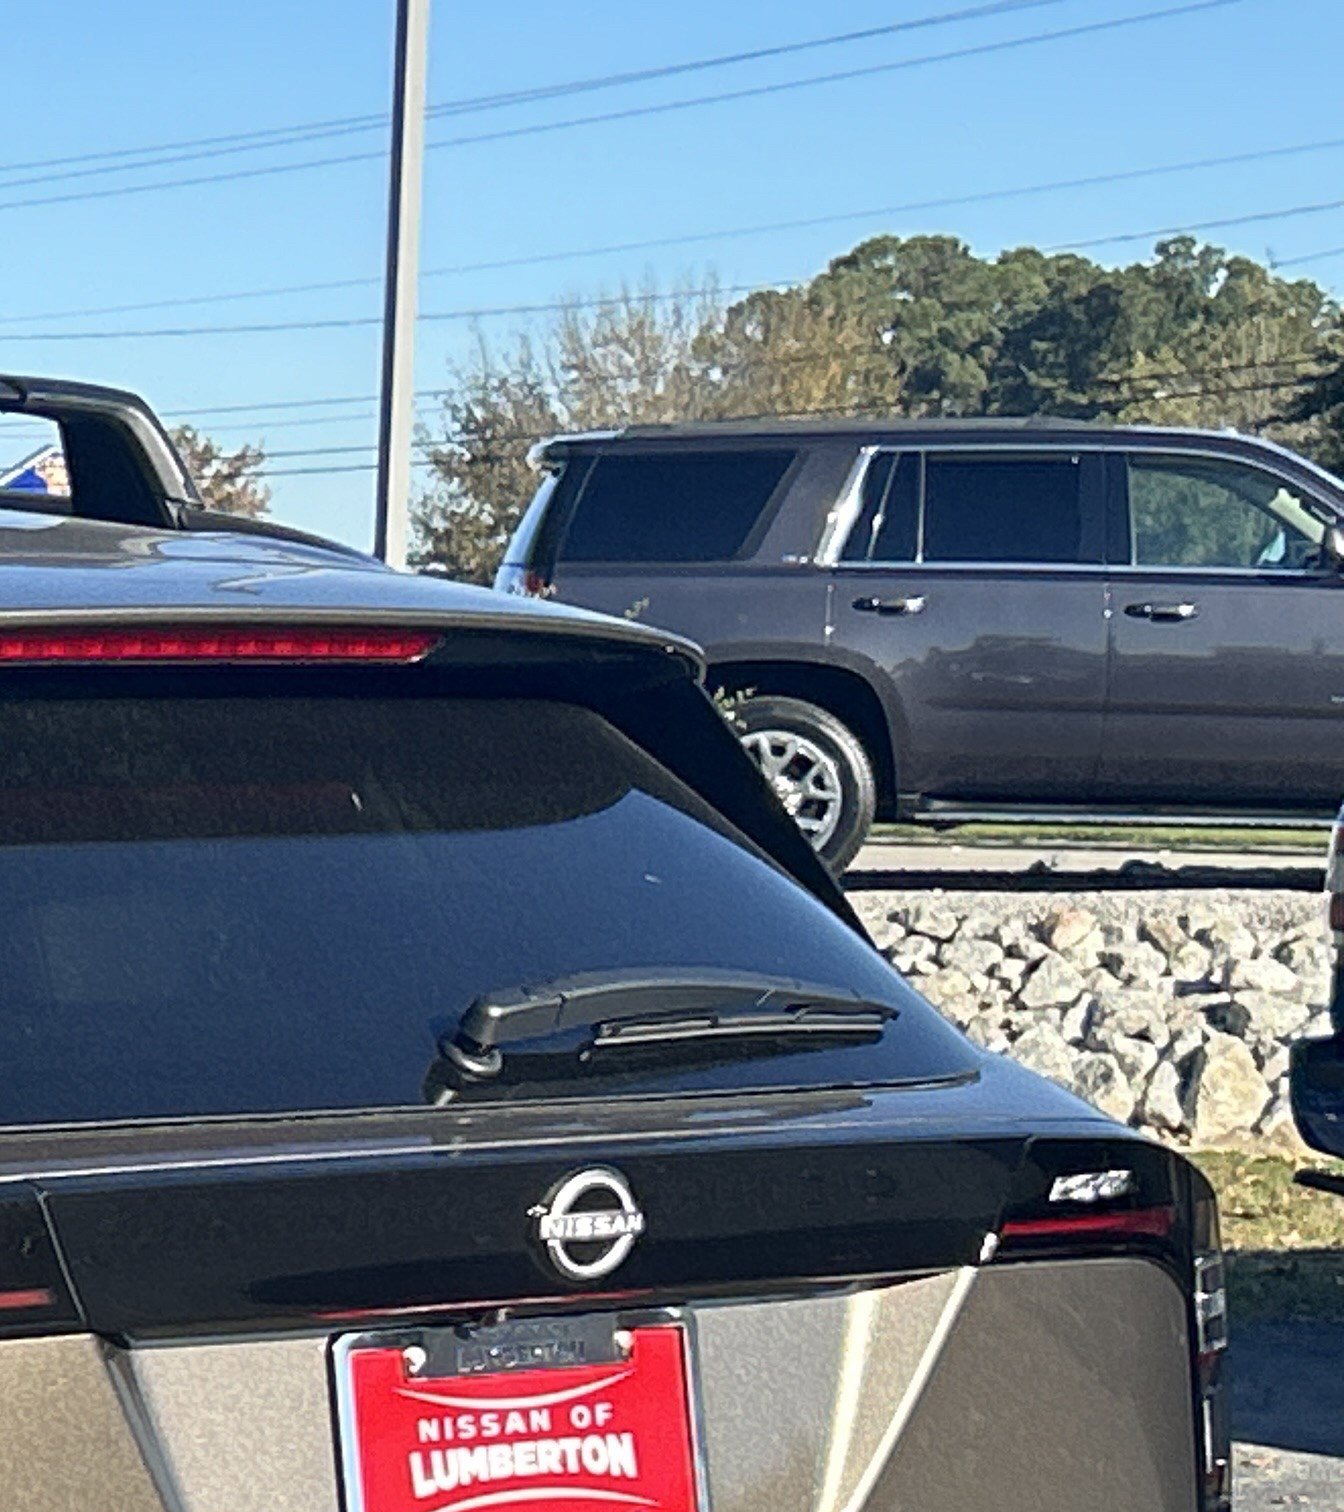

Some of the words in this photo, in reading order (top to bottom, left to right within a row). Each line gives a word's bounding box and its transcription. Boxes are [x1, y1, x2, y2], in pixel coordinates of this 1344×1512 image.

[540, 1212, 644, 1240] NISSAN
[417, 1408, 551, 1443] NISSAN
[570, 1402, 614, 1430] OF
[408, 1431, 638, 1499] LUMBERTON
